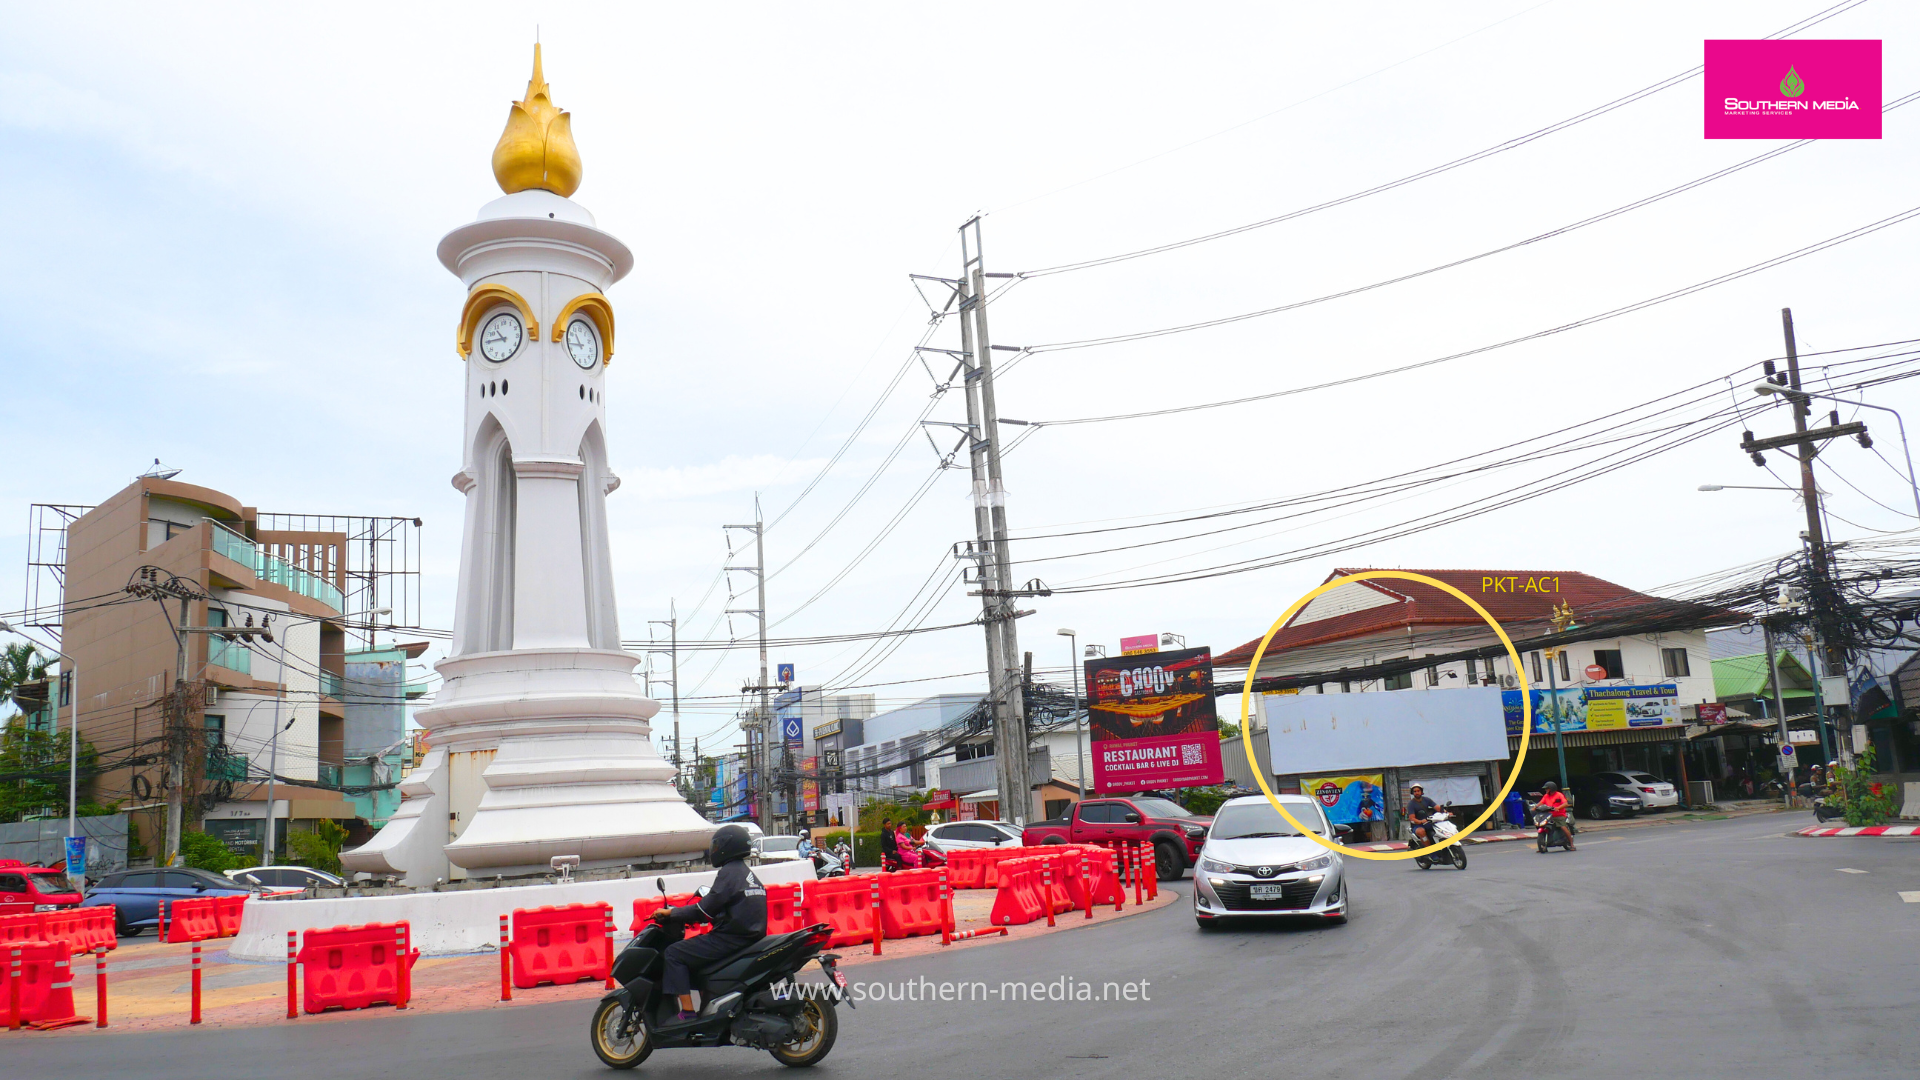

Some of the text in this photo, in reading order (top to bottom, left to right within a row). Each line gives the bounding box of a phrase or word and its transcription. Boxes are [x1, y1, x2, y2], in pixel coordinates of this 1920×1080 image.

[1588, 689, 1631, 698] Thachalong
[1630, 687, 1652, 696] Travel
[1660, 686, 1676, 695] Tour
[1103, 746, 1177, 763] RESTAURANT
[1105, 762, 1135, 772] COCKTAIL
[1136, 761, 1149, 770] BAR
[1150, 760, 1155, 768] &
[1156, 759, 1171, 768] LIVE
